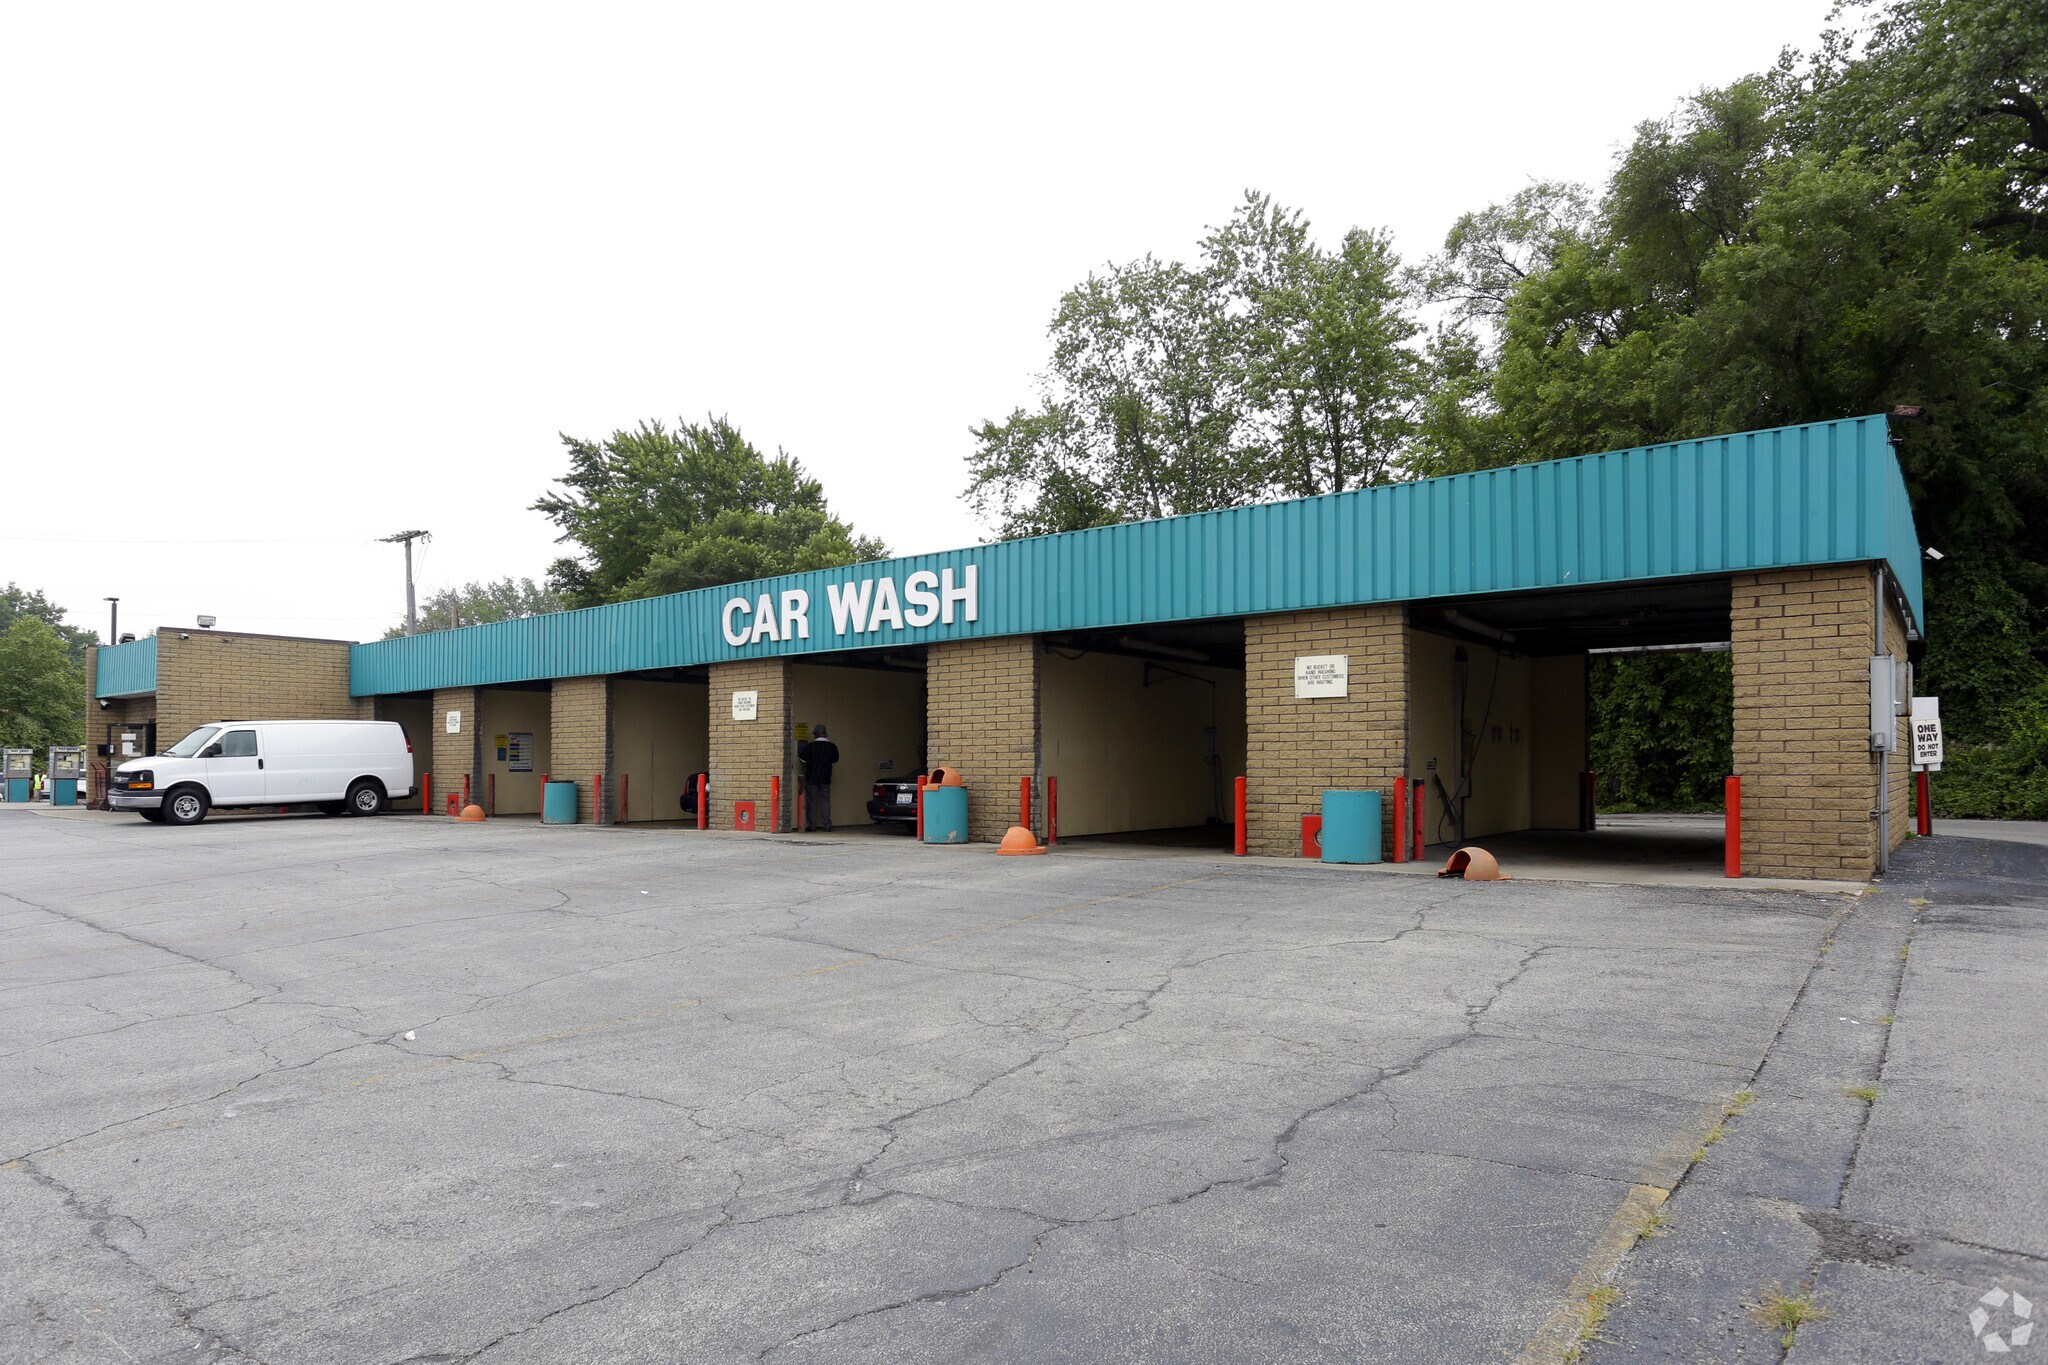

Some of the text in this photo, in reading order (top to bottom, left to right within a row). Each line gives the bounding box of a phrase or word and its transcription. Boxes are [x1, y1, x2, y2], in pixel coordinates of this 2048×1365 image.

[722, 564, 978, 647] CAR WASH
[1917, 724, 1936, 733] ONE
[1917, 733, 1938, 742] WAY
